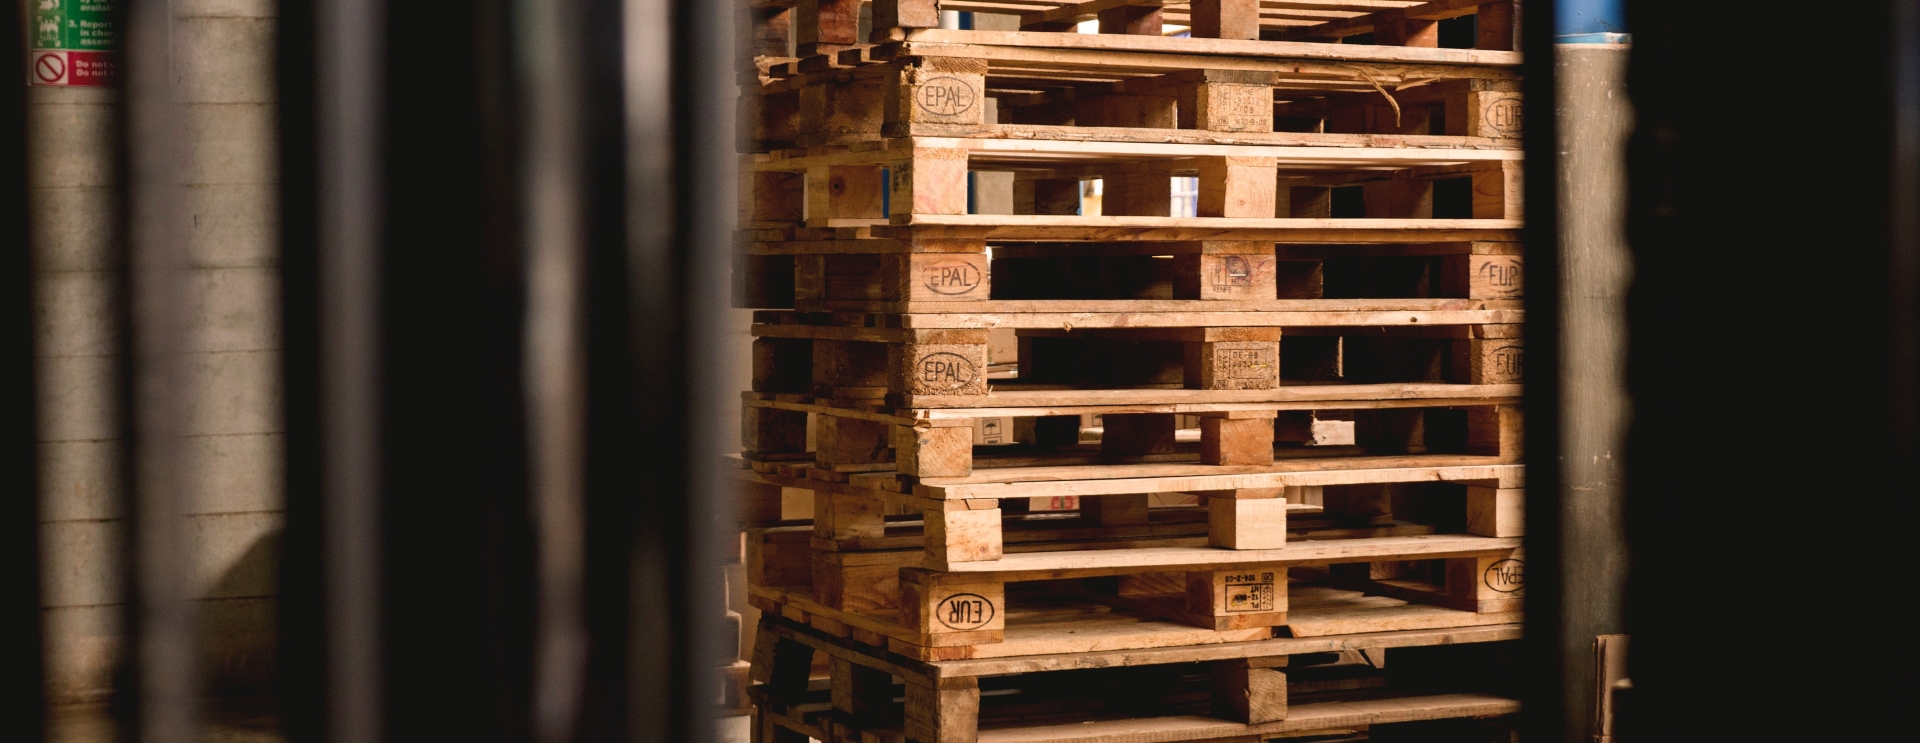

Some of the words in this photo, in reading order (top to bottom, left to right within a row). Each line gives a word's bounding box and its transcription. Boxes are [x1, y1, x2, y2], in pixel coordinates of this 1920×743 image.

[80, 19, 112, 29] Report
[92, 29, 115, 37] char
[76, 60, 89, 69] Do
[76, 69, 89, 77] Do
[92, 69, 107, 77] not
[925, 85, 967, 107] EPAL
[1496, 105, 1523, 126] EUR
[930, 266, 972, 287] EPAL
[1489, 265, 1518, 287] EUR
[924, 361, 966, 382] EPAL
[1491, 565, 1524, 586] EPAL
[949, 600, 982, 623] EUR
